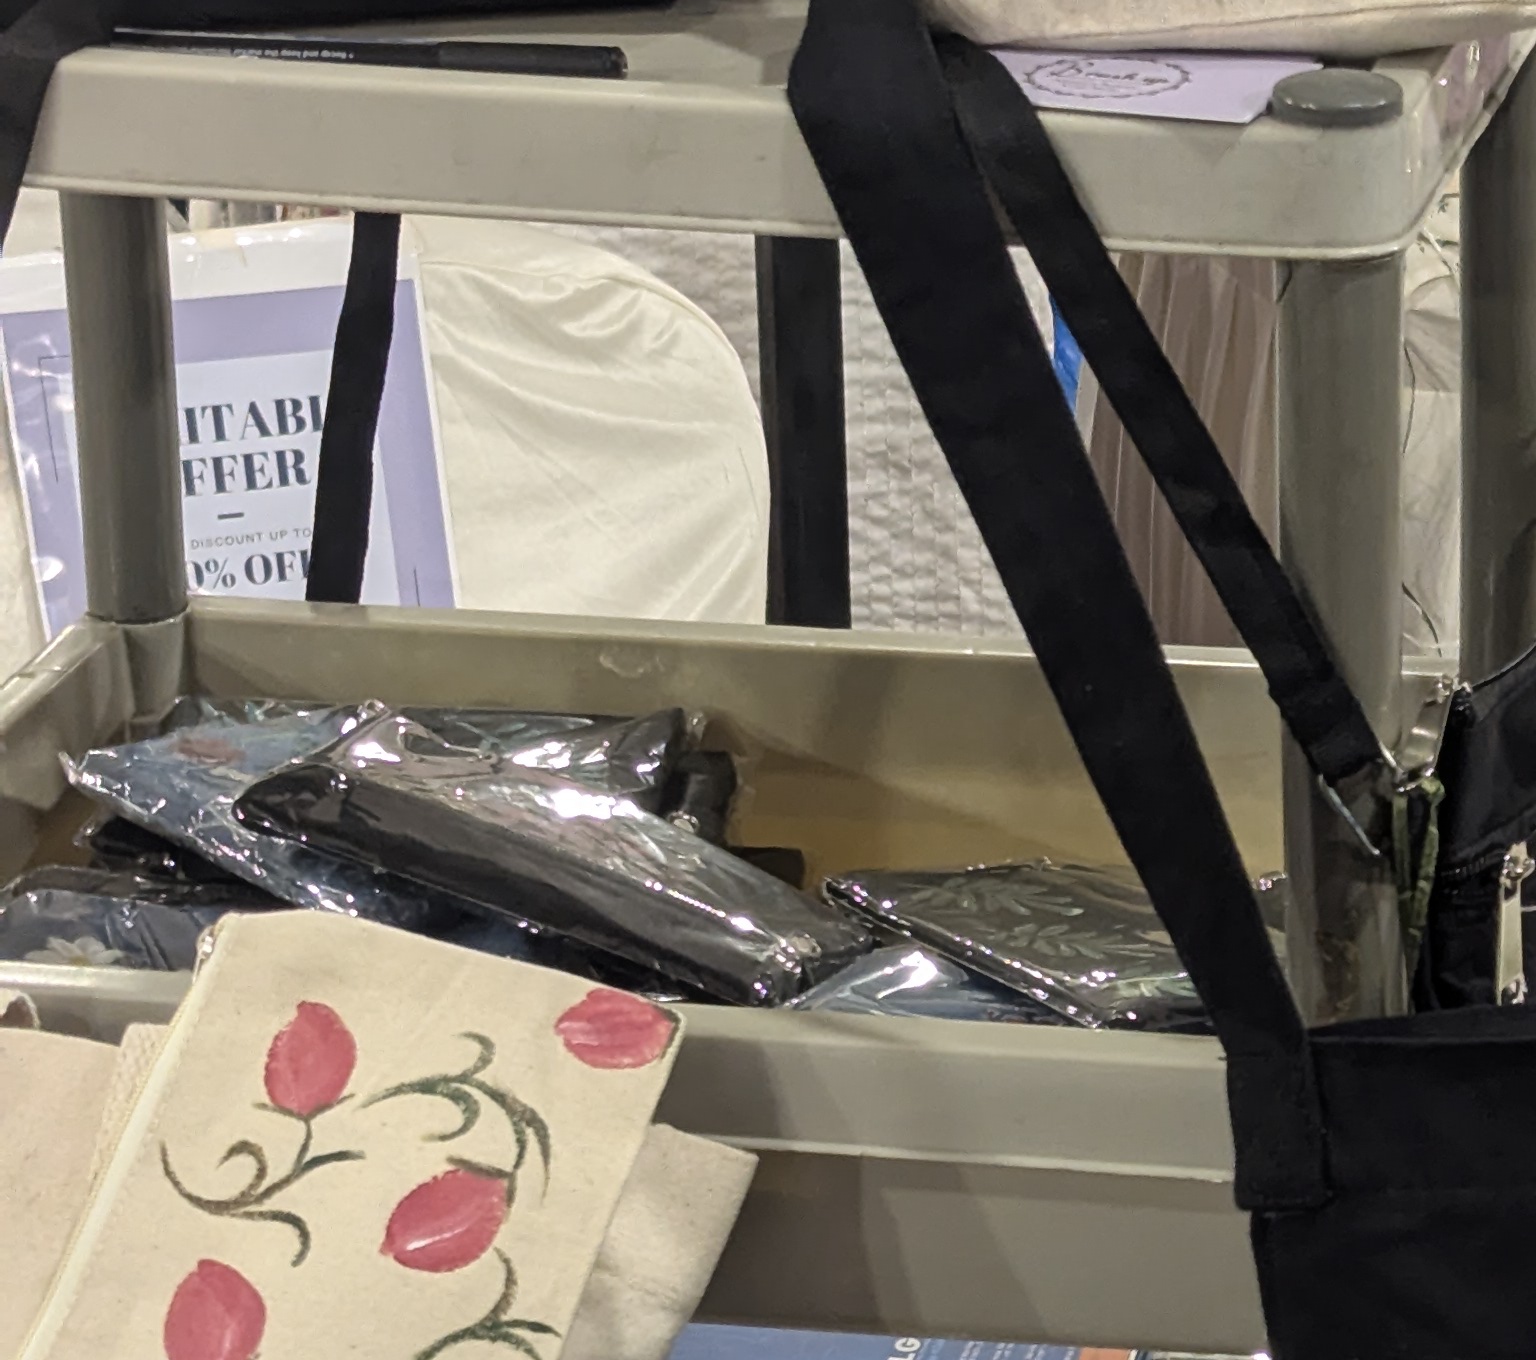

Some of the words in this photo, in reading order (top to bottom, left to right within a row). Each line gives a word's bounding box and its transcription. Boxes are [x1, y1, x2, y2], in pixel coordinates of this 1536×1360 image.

[183, 395, 324, 445] ITABL
[181, 448, 312, 497] FFER
[191, 532, 264, 551] DISCOUNT
[269, 530, 288, 541] UP
[294, 527, 312, 538] TO
[188, 556, 237, 590] 0%
